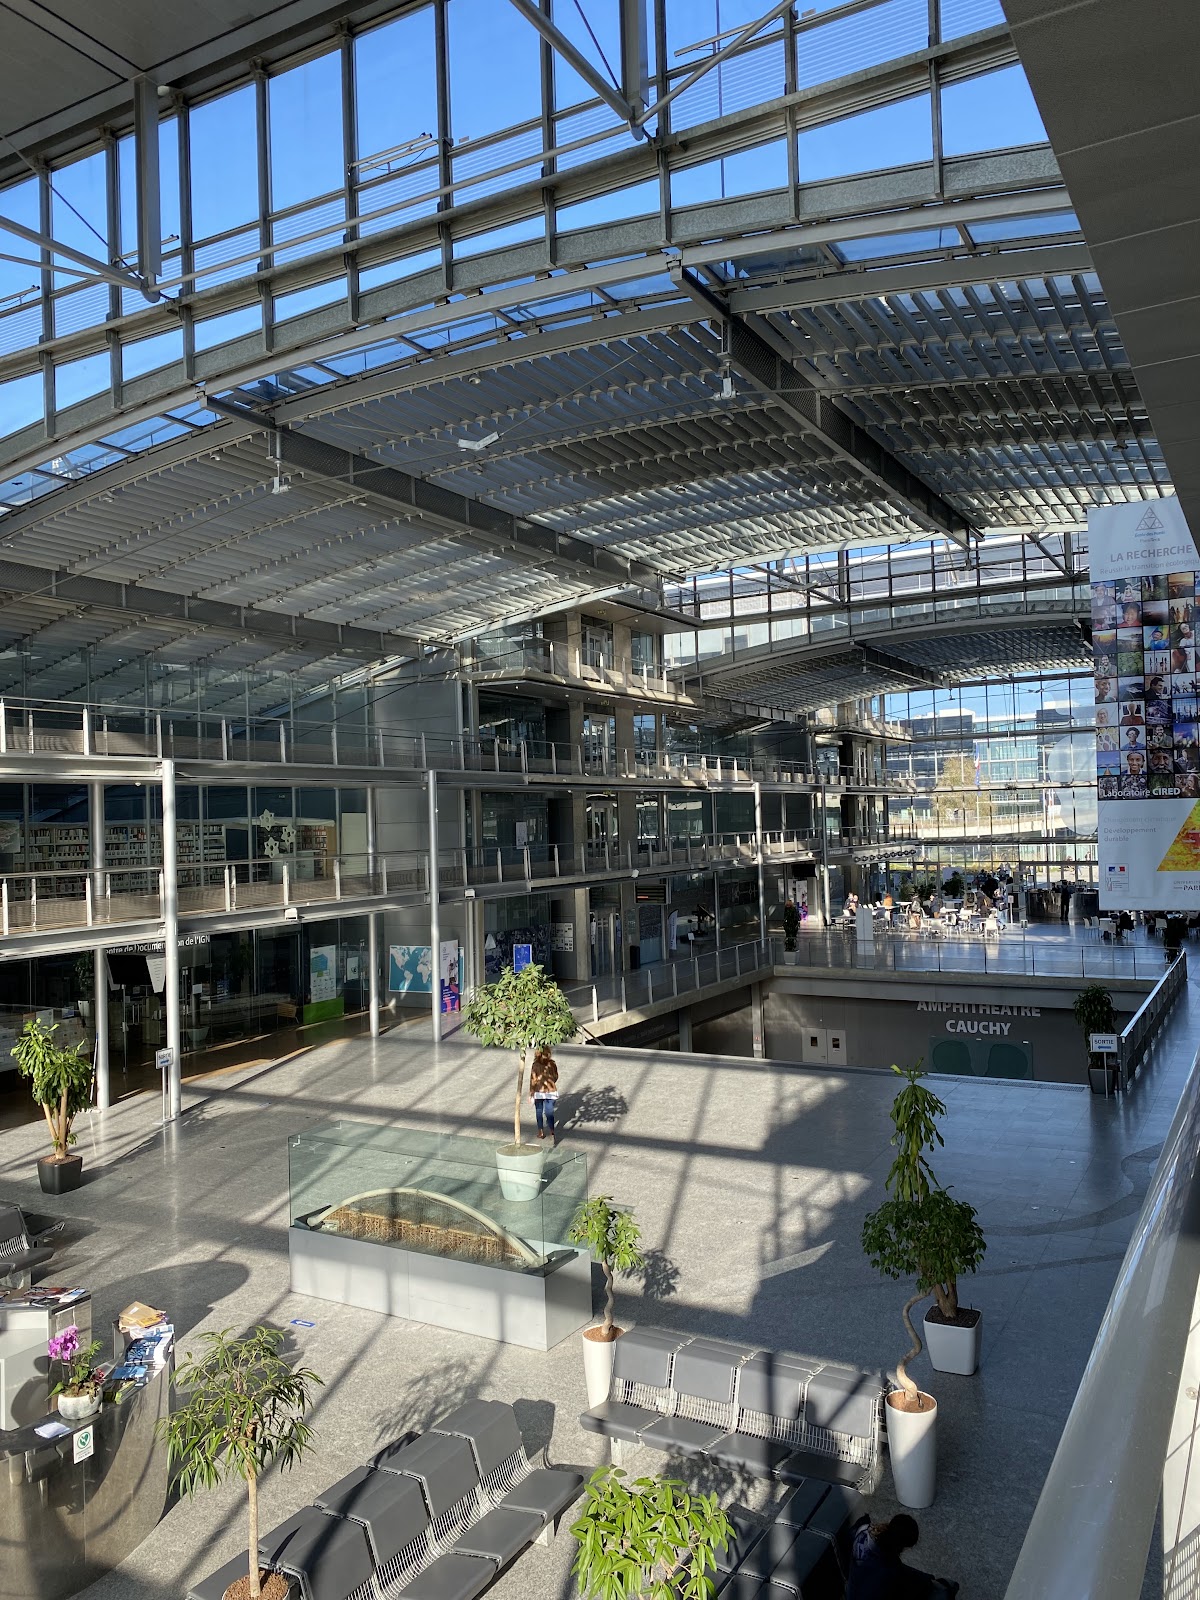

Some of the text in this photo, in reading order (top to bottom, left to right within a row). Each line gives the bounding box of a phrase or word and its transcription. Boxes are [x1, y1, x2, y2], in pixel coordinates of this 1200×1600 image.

[1110, 544, 1193, 563] LA RECHERCHE
[1132, 562, 1164, 571] transition
[1103, 787, 1181, 798] Laboratoire CIRED
[186, 936, 194, 946] de
[194, 934, 211, 945] l'IGN
[945, 1019, 1012, 1036] CAUCHY
